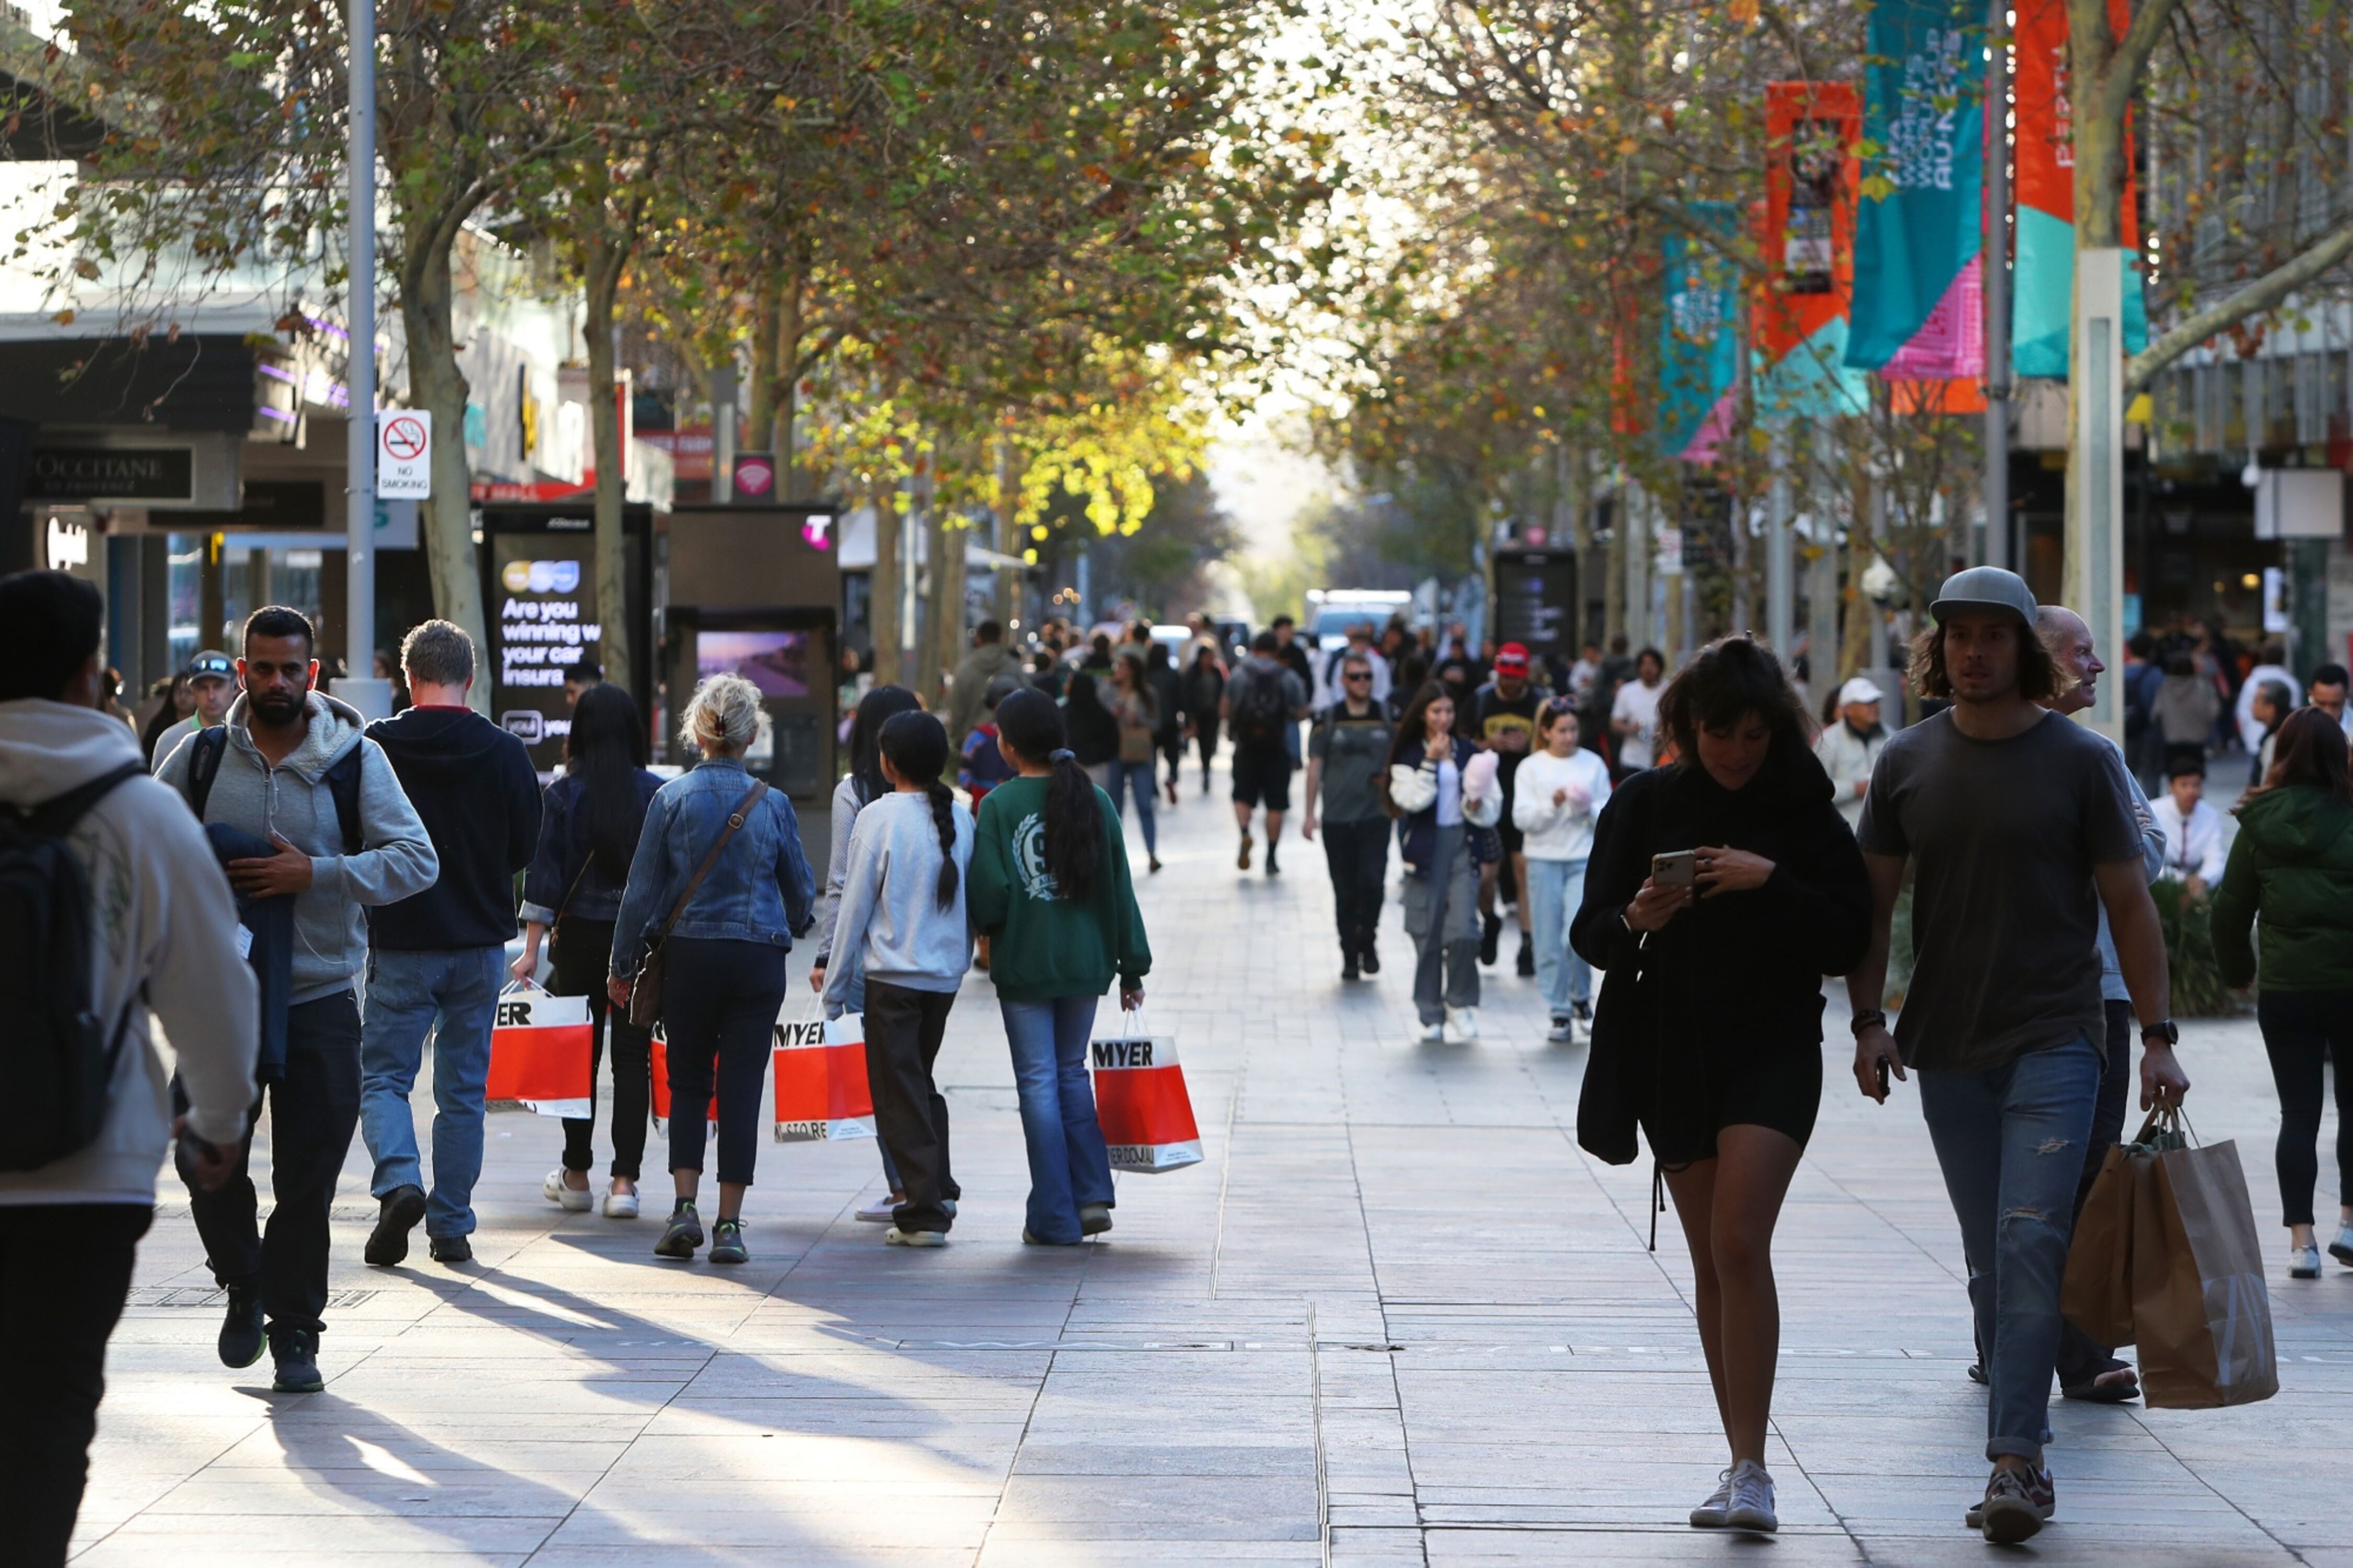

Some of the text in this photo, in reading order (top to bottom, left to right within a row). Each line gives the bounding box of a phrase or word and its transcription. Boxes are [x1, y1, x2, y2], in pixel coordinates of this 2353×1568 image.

[397, 466, 413, 476] NO
[381, 479, 428, 490] SMOKING
[501, 598, 578, 623] Are you
[502, 620, 581, 646] winning
[501, 646, 585, 669] your car
[1092, 1041, 1153, 1067] MYER
